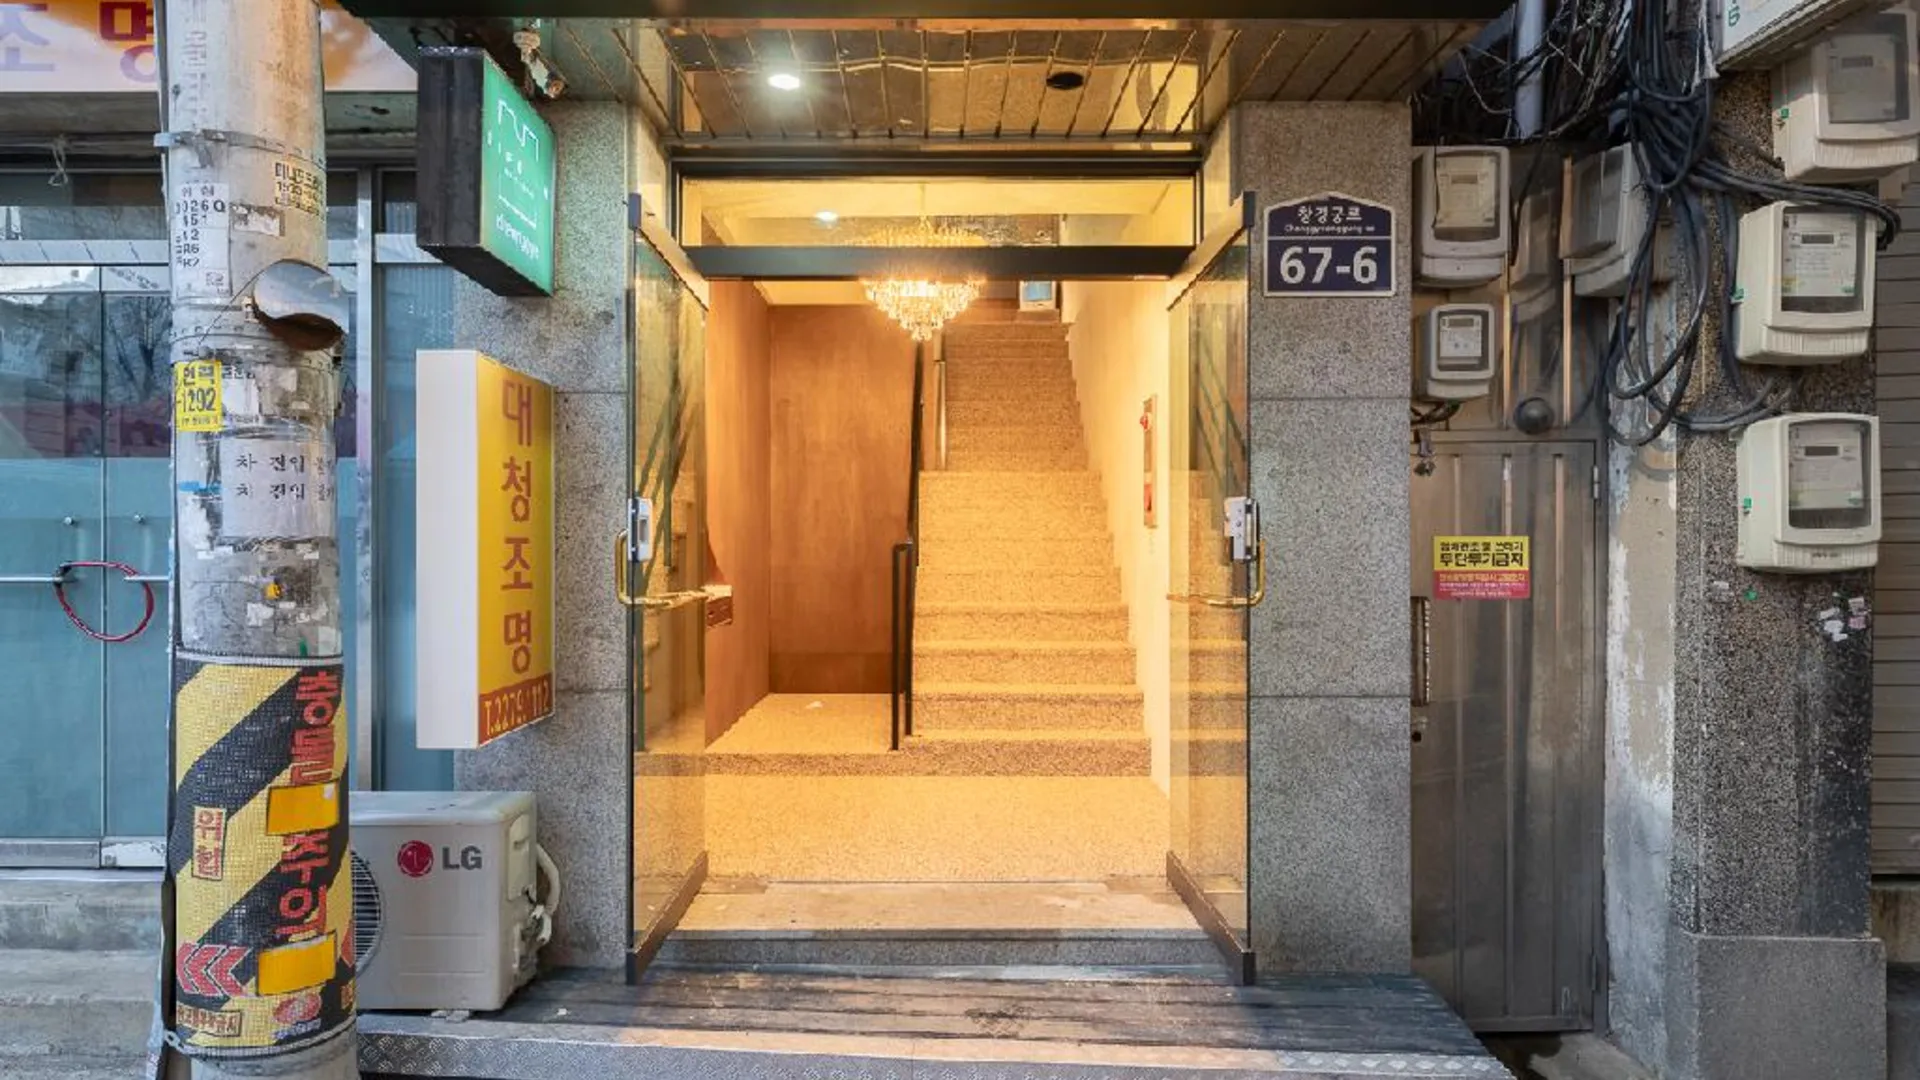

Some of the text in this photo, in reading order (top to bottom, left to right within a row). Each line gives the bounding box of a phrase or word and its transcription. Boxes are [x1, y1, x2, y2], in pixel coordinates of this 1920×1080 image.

[1297, 205, 1362, 224] 창경궁로
[1280, 246, 1377, 284] 67-6
[501, 378, 534, 675] 대청조명
[442, 846, 483, 871] LG
